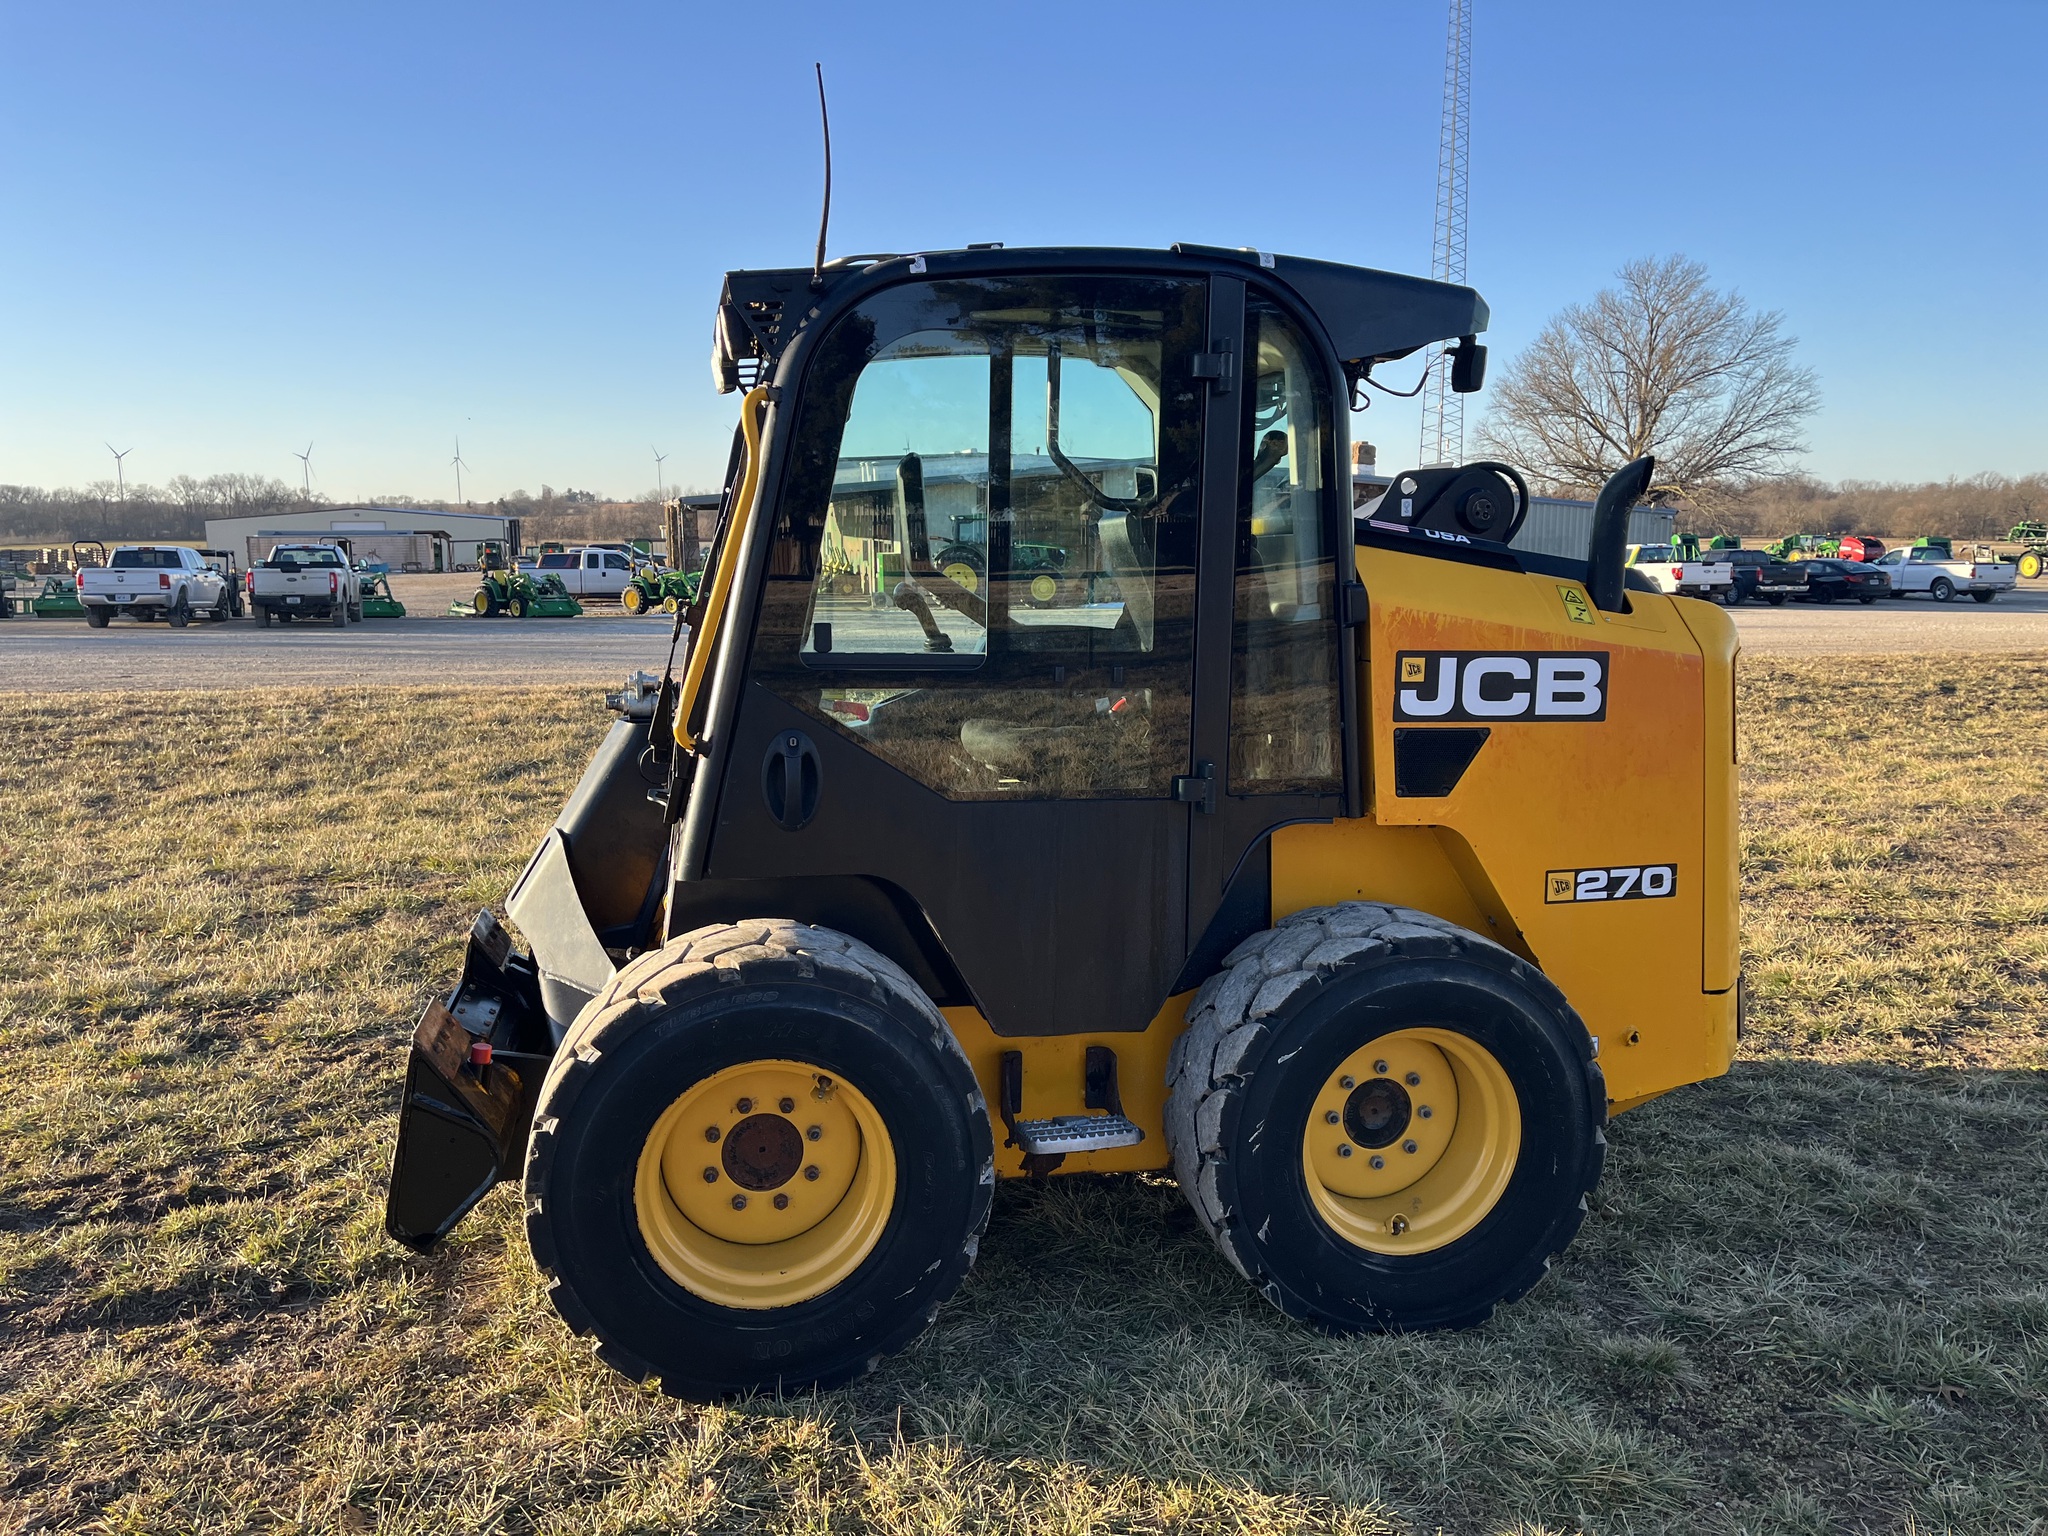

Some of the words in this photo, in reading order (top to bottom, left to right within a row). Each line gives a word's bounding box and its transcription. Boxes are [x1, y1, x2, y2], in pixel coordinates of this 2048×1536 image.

[1424, 528, 1472, 545] USA
[1407, 663, 1423, 676] JCB
[1399, 656, 1602, 717] JCB
[1554, 880, 1570, 894] JCB
[1576, 866, 1673, 901] 270
